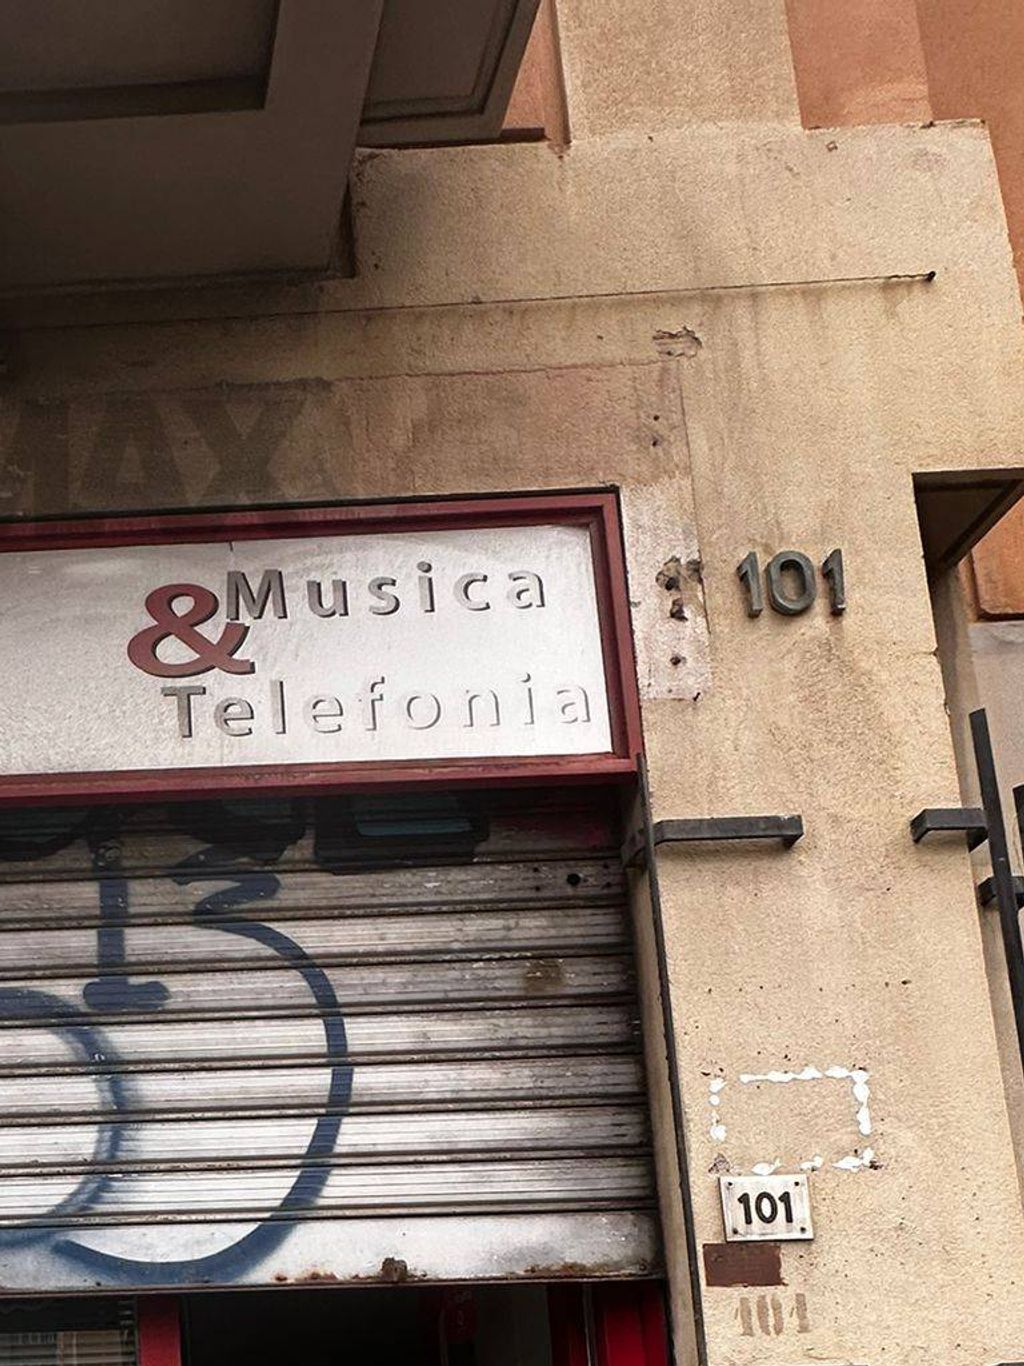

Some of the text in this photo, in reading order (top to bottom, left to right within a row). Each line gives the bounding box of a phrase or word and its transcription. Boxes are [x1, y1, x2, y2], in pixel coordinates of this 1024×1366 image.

[736, 548, 847, 618] 101
[126, 560, 548, 677] & Musica
[161, 672, 592, 739] Telefonia
[737, 1191, 793, 1225] 101
